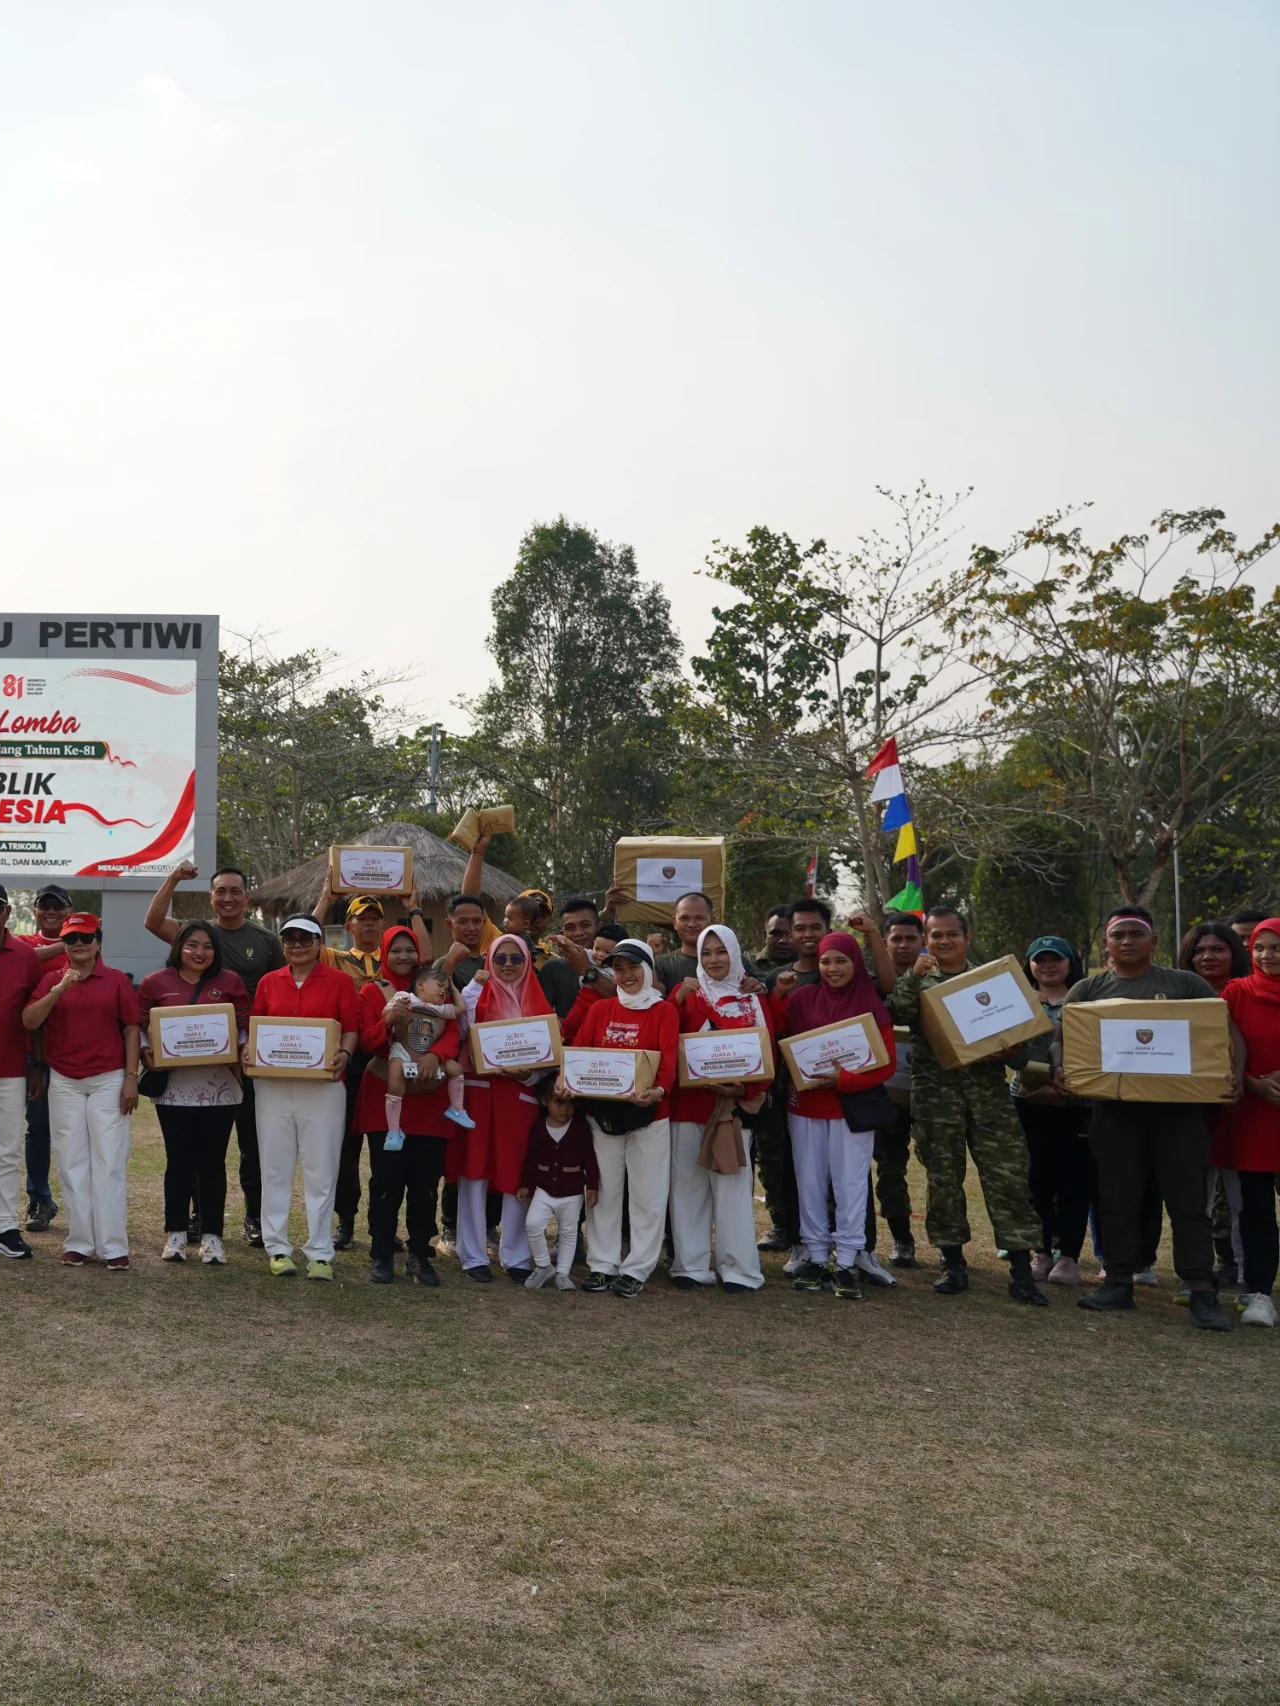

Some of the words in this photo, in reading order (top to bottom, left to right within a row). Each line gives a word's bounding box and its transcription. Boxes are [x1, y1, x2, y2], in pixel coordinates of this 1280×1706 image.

[39, 621, 202, 649] PERTIWI
[3, 674, 24, 699] 81
[25, 744, 61, 756] Tahun
[63, 745, 96, 756] Ke-81
[8, 842, 44, 851] TRIKORA
[141, 865, 171, 873] AGUSTUS
[812, 1062, 833, 1072] REPUBLI
